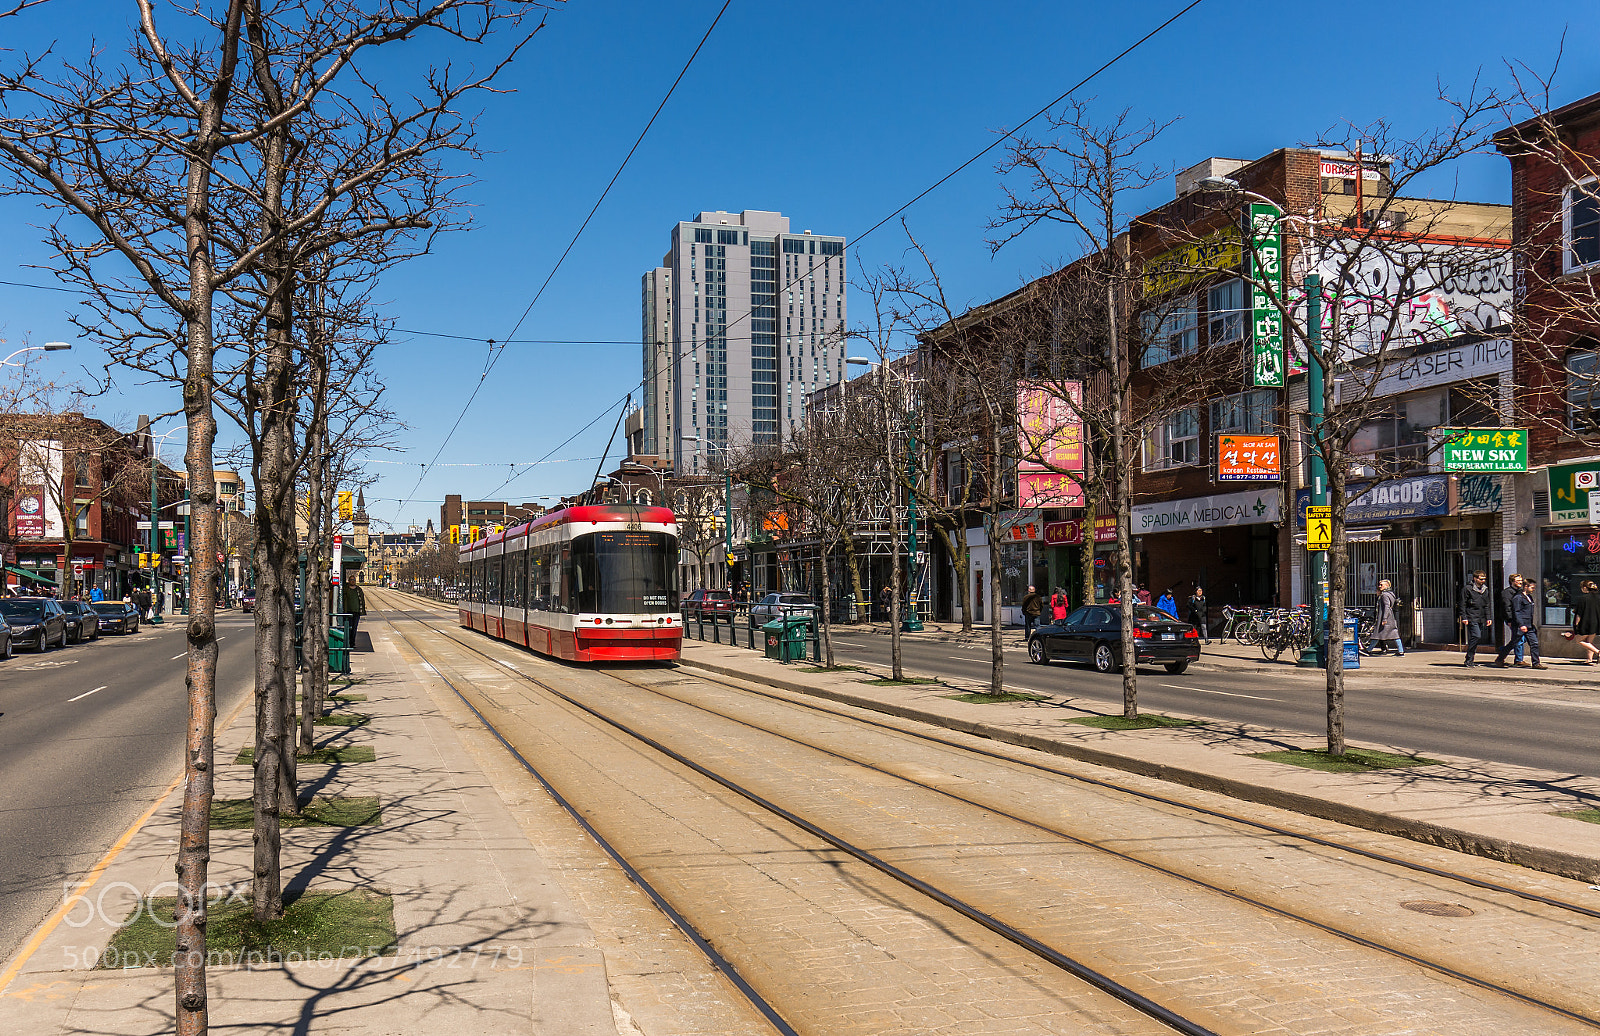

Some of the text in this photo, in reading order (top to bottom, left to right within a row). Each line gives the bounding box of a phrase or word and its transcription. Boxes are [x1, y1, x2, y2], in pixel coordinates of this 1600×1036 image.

[1399, 349, 1464, 380] LASER
[1451, 449, 1519, 462] NEW SKY
[1447, 462, 1494, 470] RESTAURANT
[1371, 479, 1424, 505] JACOB
[1141, 503, 1251, 529] SPADINA MEDICAL
[1558, 511, 1588, 519] NEW
